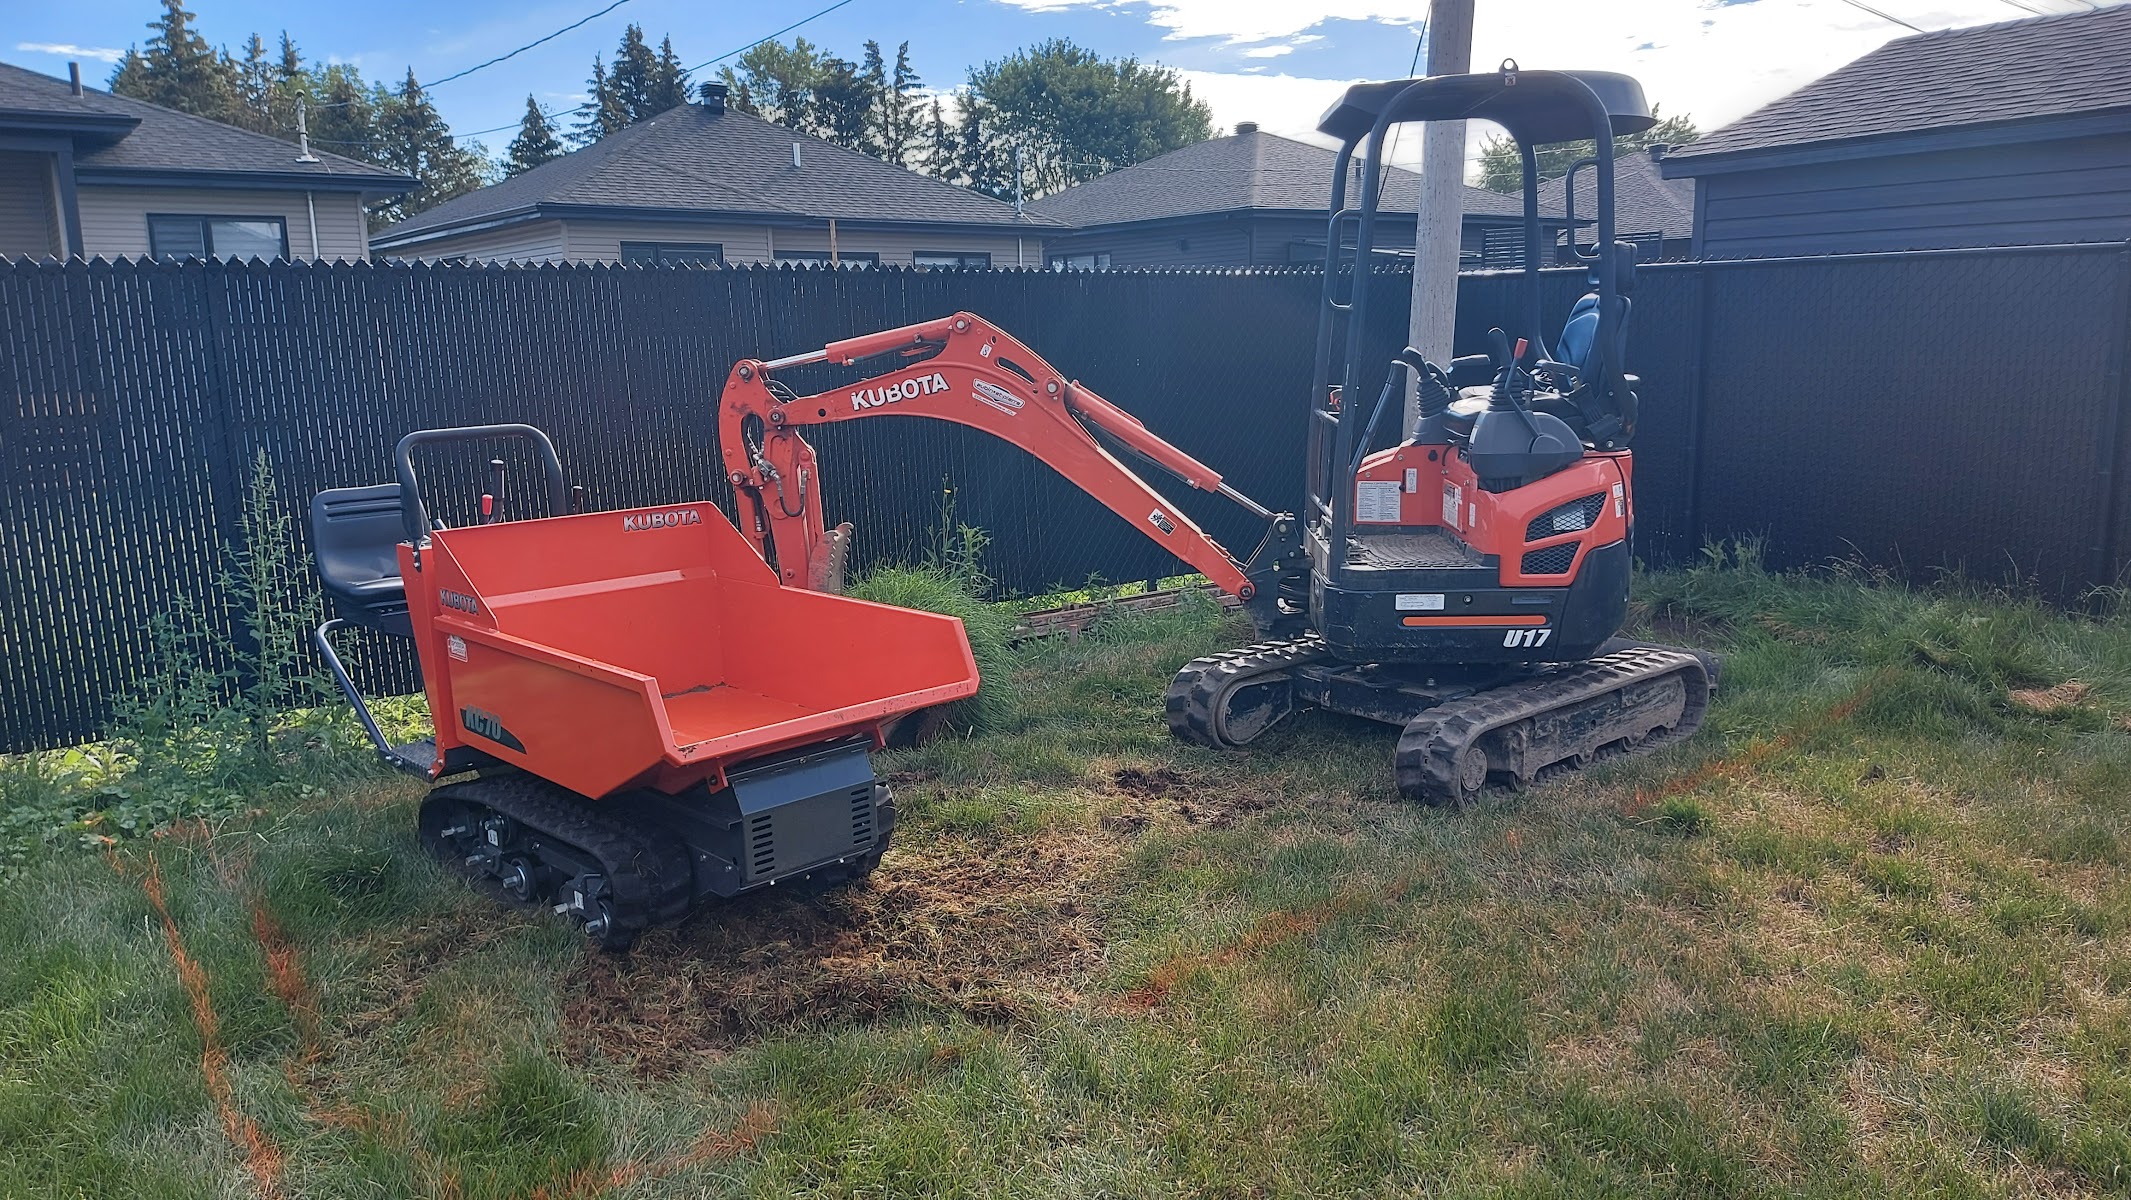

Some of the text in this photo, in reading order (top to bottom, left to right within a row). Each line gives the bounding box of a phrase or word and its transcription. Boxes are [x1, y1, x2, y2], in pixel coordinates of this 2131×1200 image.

[851, 372, 949, 411] KUBOTA
[623, 508, 702, 532] KUBOTA
[440, 589, 479, 615] KUBOTA
[1503, 629, 1552, 647] U17
[465, 704, 502, 740] KC70
